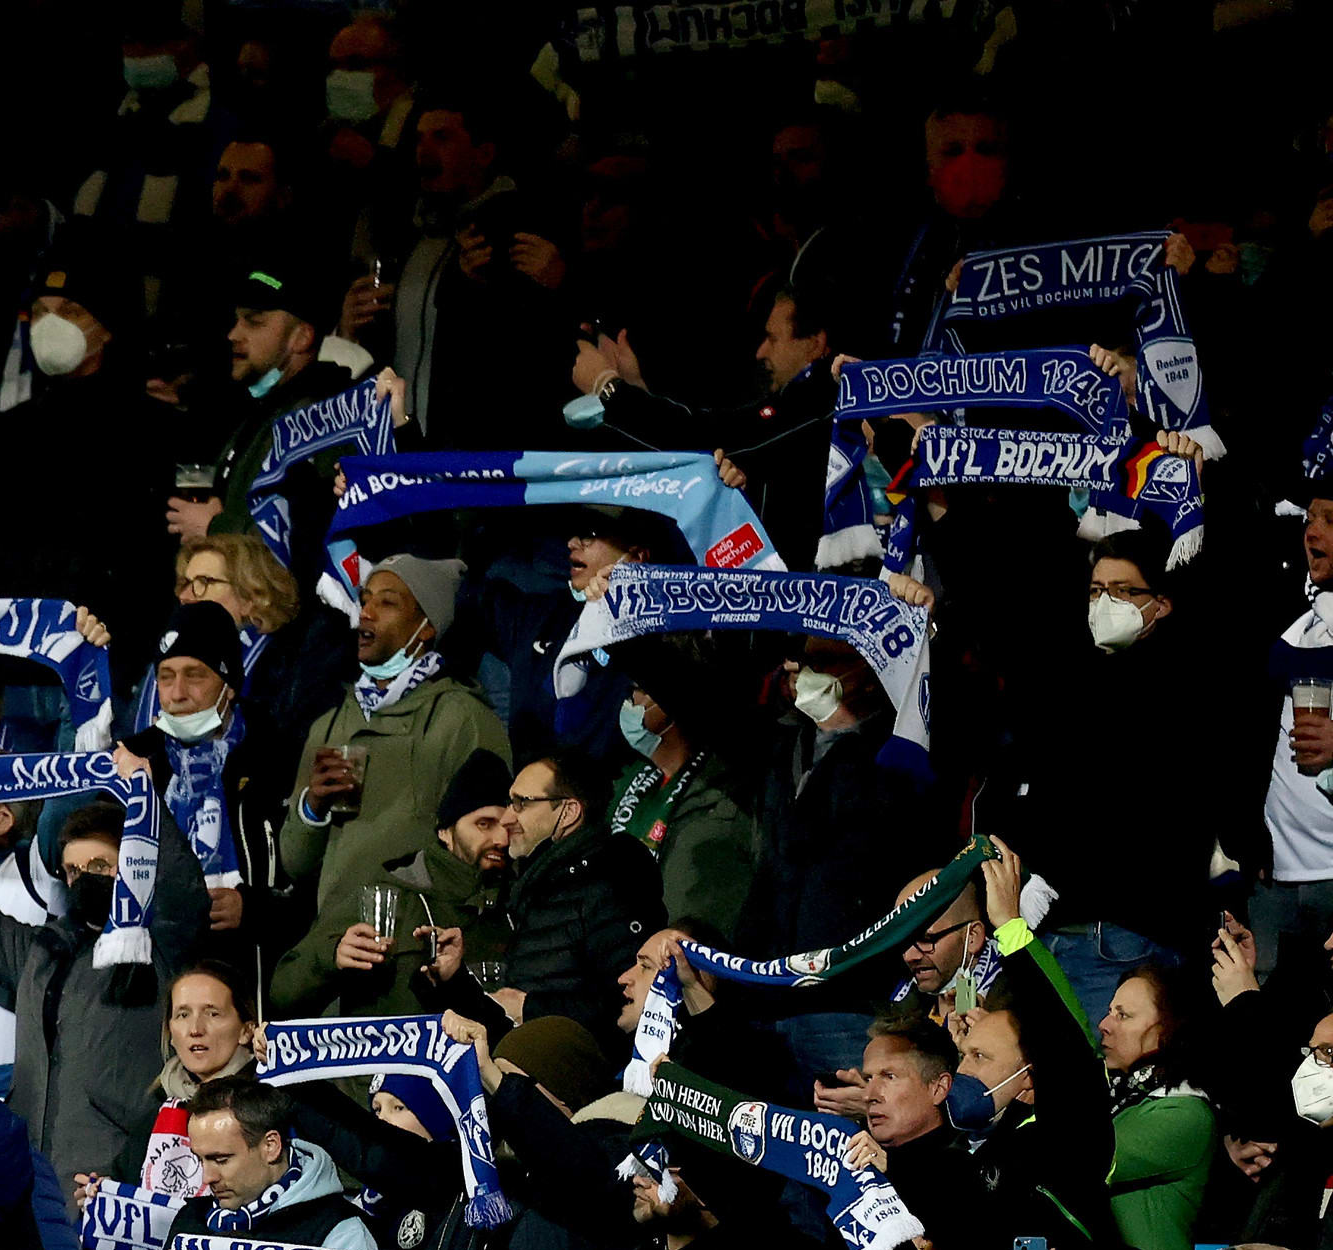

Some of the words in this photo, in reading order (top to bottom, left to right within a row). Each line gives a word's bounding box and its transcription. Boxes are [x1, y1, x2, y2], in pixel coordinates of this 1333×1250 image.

[864, 357, 1027, 403] BOCHUM
[1155, 356, 1192, 371] Bochum
[1165, 369, 1189, 383] 1848
[285, 392, 359, 447] BOCHUM
[925, 438, 983, 479] VfL
[995, 439, 1120, 482] BOCHUM
[666, 578, 838, 620] BOCHUM
[308, 1020, 421, 1063] BOCHUM
[679, 1082, 723, 1118] HERZEN
[698, 1117, 729, 1145] HIER.
[770, 1112, 797, 1143] VfL
[149, 1136, 182, 1166] AJAX
[804, 1149, 841, 1187] 1848
[873, 1204, 902, 1224] 1848
